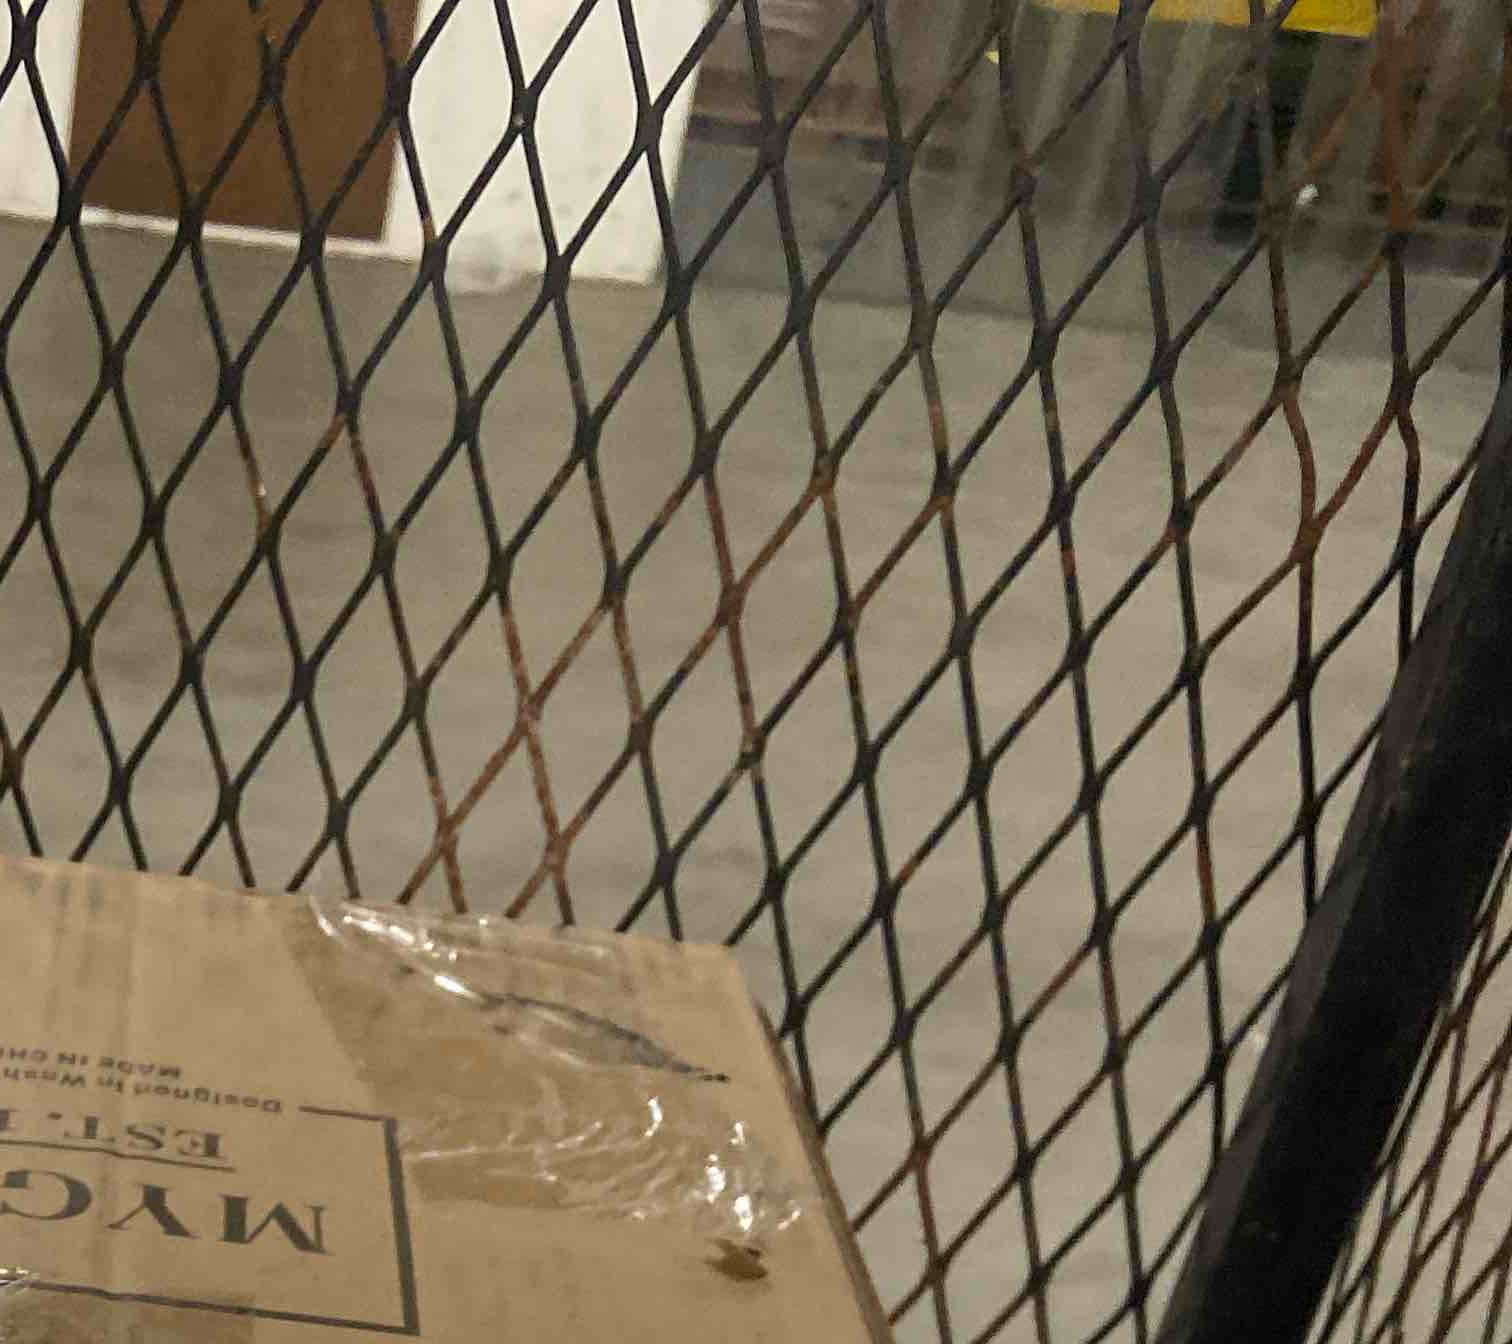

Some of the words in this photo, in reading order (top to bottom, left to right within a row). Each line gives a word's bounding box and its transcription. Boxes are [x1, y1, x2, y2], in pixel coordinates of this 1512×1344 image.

[56, 1052, 88, 1067] IN
[98, 1055, 181, 1078] MADE
[134, 1083, 281, 1113] Designed
[46, 1111, 227, 1159] EST.
